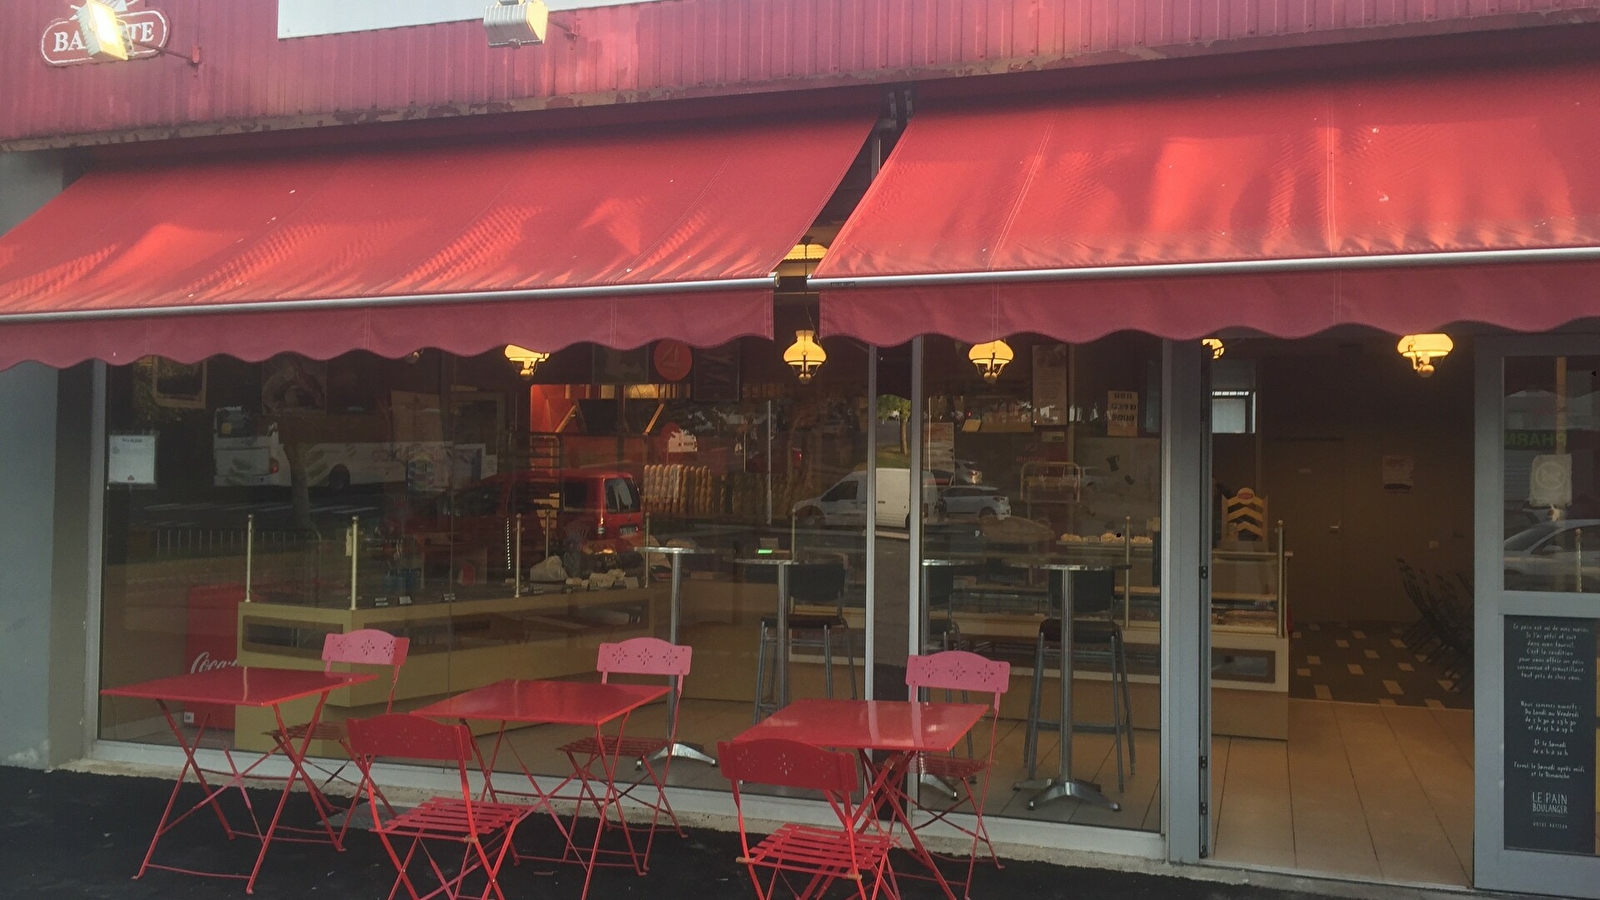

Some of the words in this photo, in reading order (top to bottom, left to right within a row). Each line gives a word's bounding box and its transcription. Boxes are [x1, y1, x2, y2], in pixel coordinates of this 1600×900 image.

[1532, 792, 1542, 803] LE
[1546, 792, 1568, 805] PAIN
[1533, 803, 1568, 814] BOULANGER
